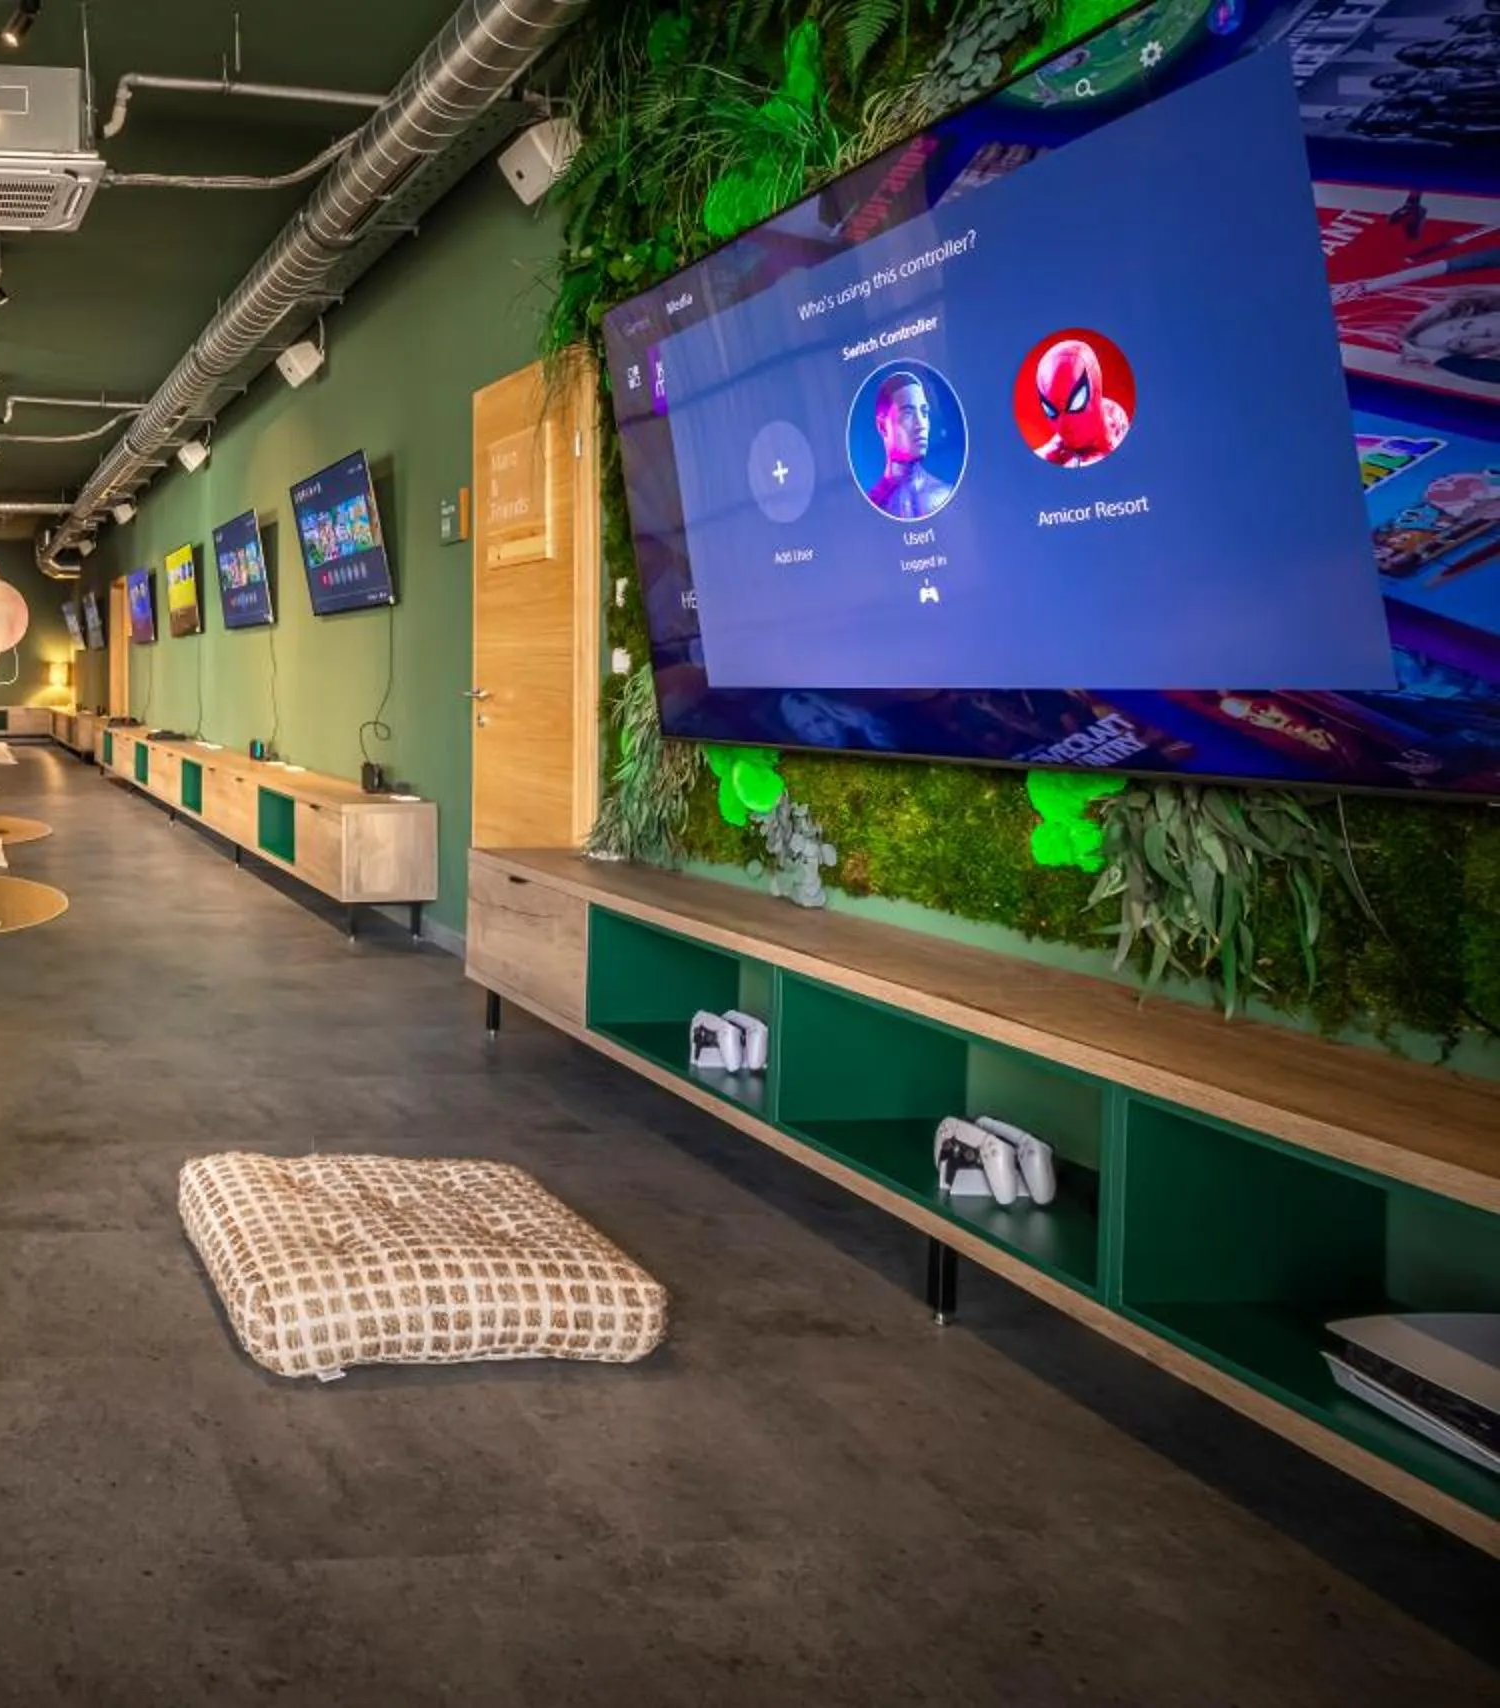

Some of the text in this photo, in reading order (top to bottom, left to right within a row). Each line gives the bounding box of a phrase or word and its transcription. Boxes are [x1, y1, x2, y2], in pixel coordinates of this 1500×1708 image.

[797, 228, 978, 321] Who's using this controller?
[842, 316, 939, 361] Switch Controller
[1037, 495, 1150, 527] Amicor Resort
[774, 552, 793, 564] Add
[900, 555, 948, 573] Logged in
